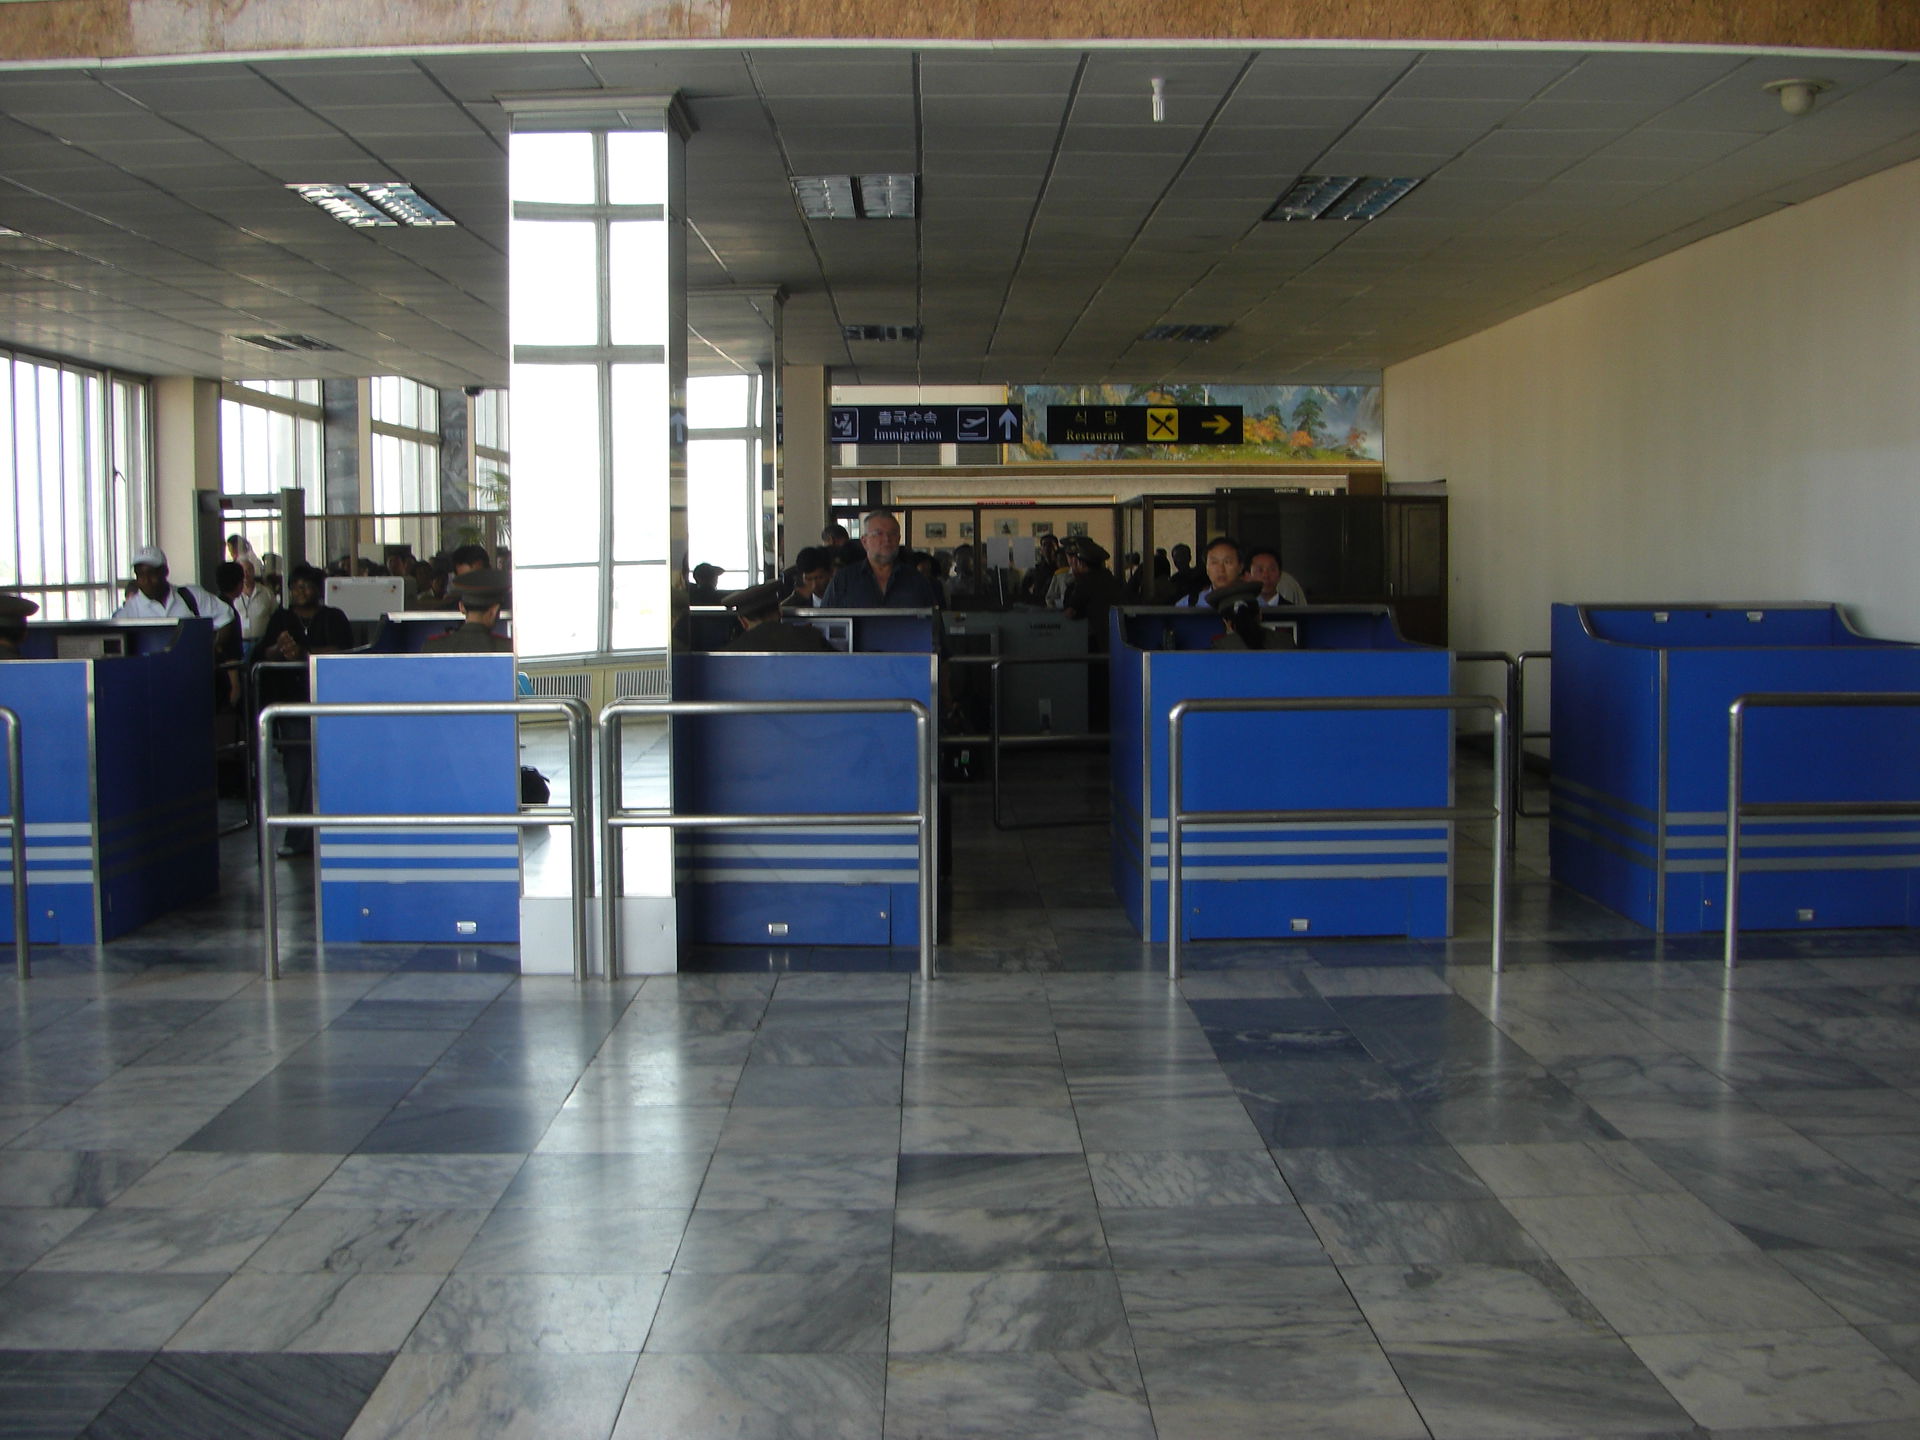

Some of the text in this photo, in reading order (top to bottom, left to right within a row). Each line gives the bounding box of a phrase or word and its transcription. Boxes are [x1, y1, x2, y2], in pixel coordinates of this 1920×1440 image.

[878, 410, 938, 426] 출국수속
[874, 427, 943, 443] Immigration
[1066, 428, 1125, 441] Restaurant
